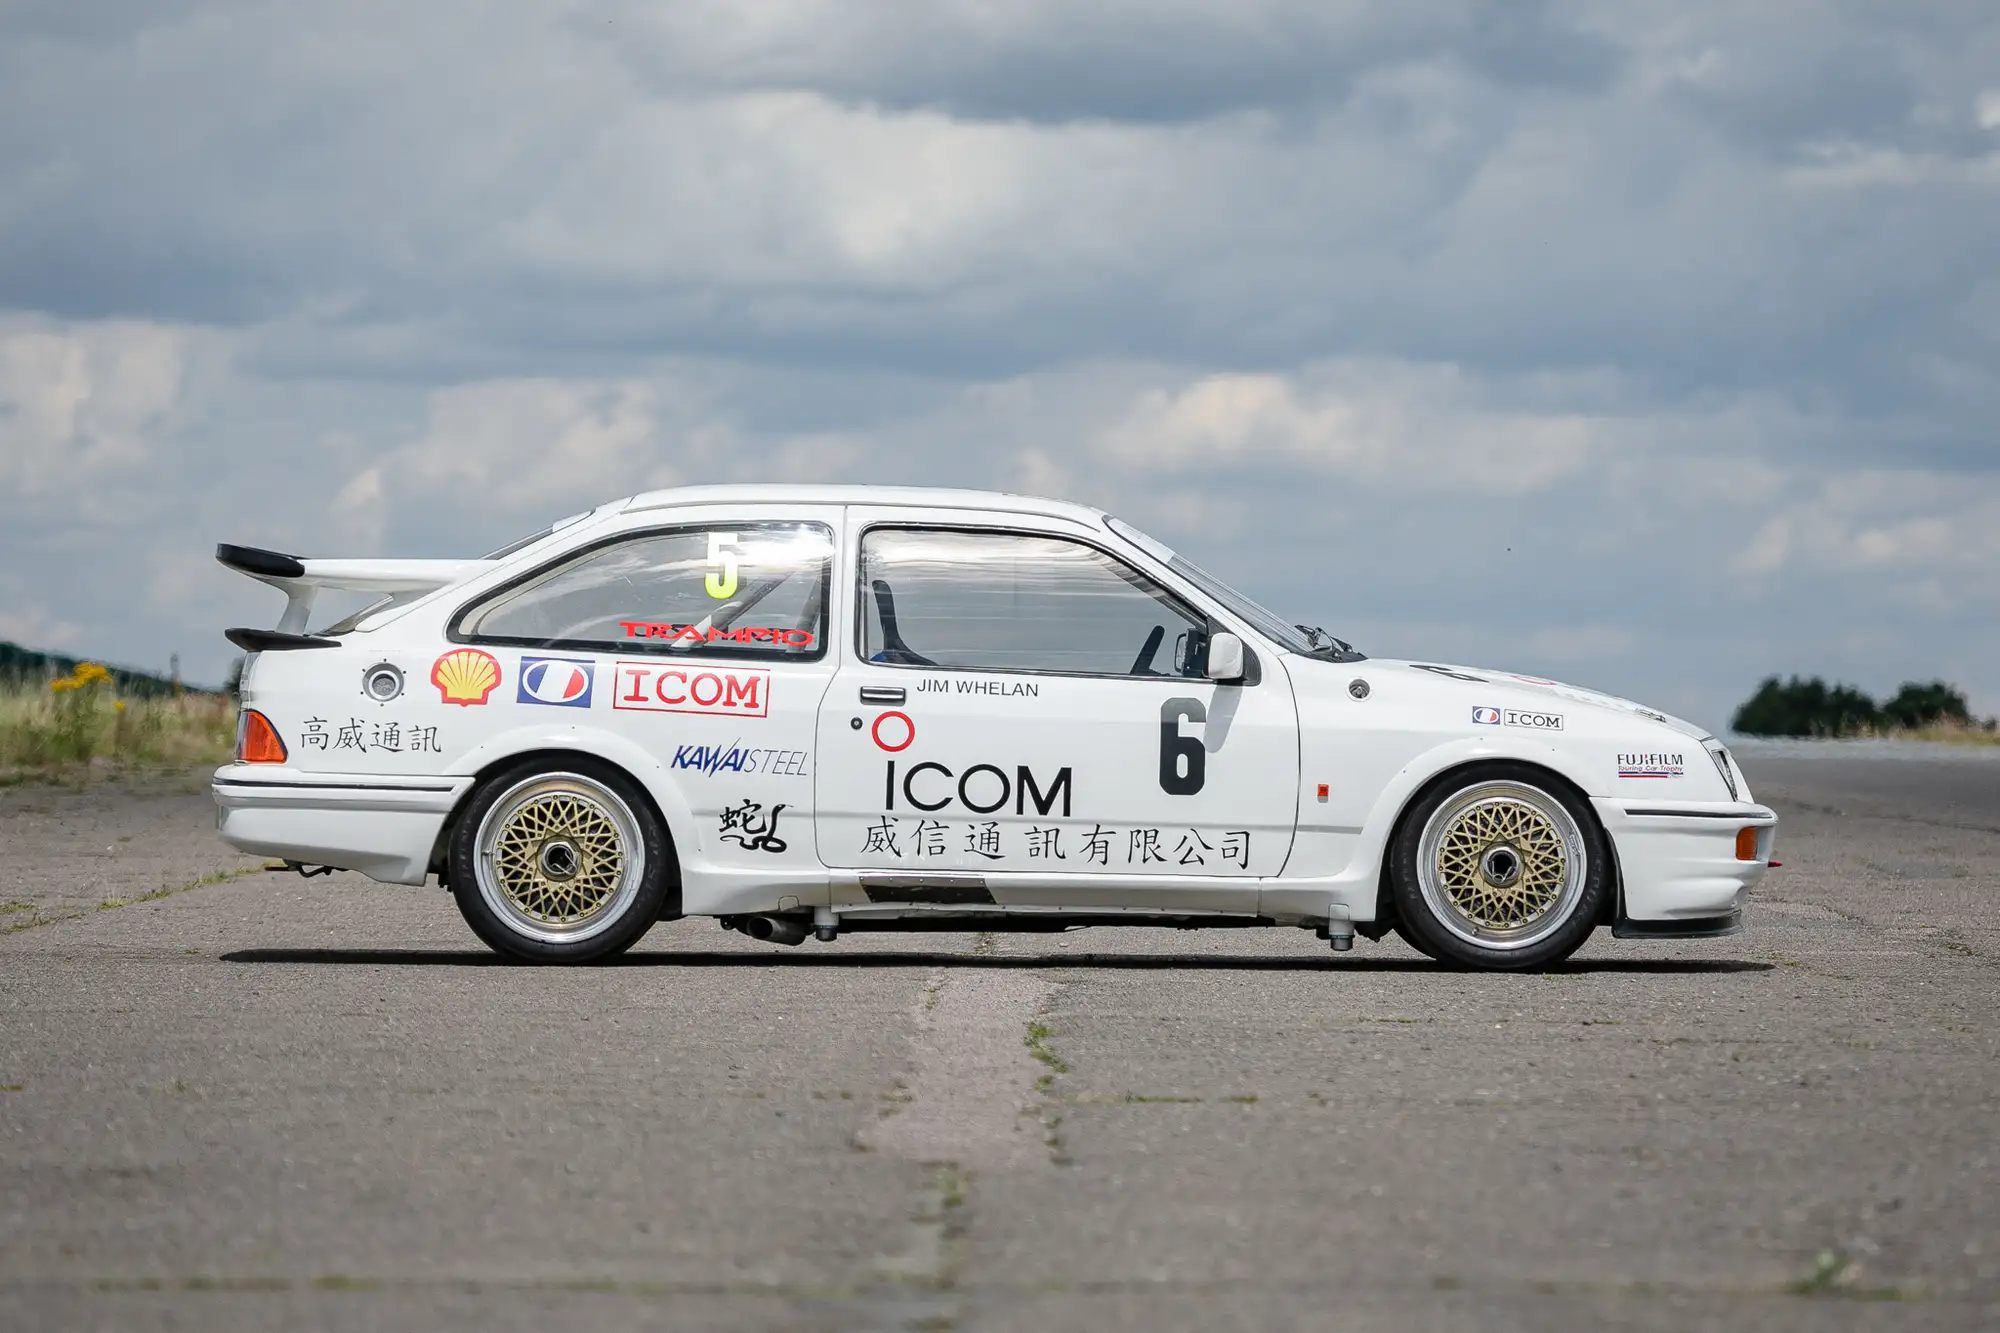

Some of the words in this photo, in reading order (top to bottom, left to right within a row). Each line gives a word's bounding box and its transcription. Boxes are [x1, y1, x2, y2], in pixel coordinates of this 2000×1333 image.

[704, 532, 738, 600] 5
[623, 669, 761, 709] ICOM
[916, 679, 950, 694] JIM
[956, 680, 1039, 698] WHELAN
[300, 716, 442, 753] 高威通訊
[1508, 712, 1560, 728] ICOM
[1159, 697, 1206, 796] 6
[885, 760, 1073, 817] ICOM
[1660, 765, 1683, 773] Trophy
[859, 815, 1252, 870] 威信通訊有限公司
